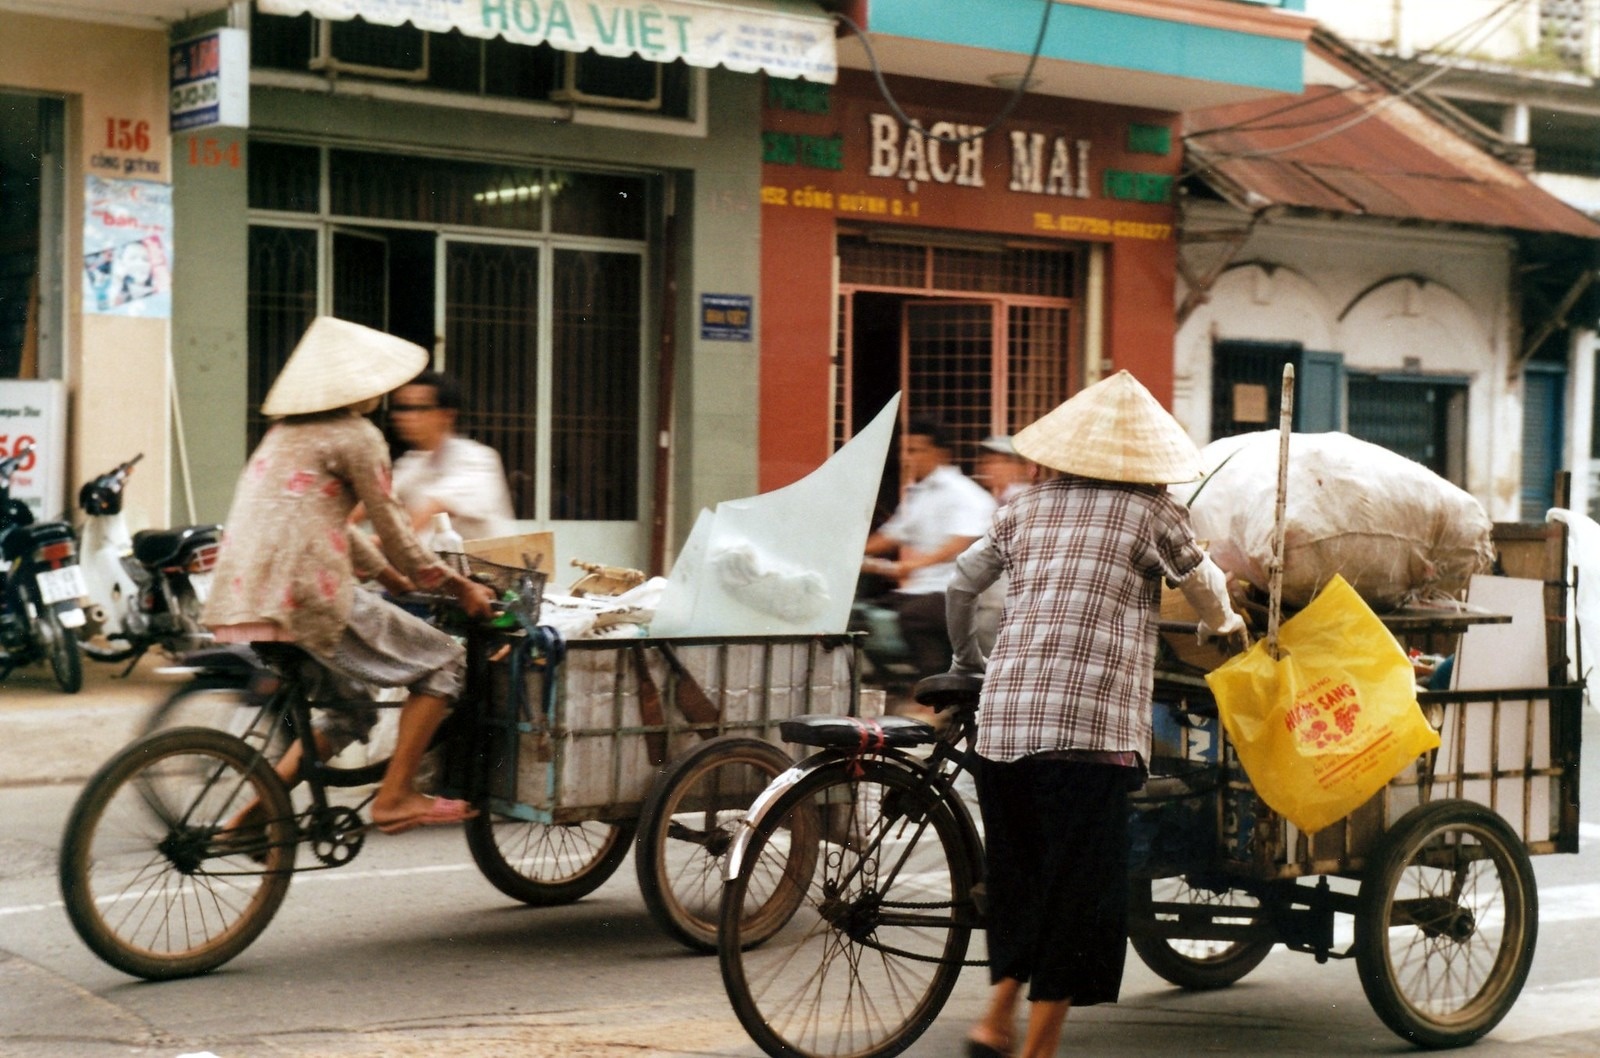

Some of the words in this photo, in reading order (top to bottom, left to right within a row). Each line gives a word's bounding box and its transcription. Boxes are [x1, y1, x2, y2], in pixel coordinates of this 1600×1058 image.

[588, 4, 693, 56] VIỆT
[104, 117, 152, 153] 156
[187, 135, 242, 170] 154
[869, 112, 986, 193] BẠCH
[1009, 130, 1092, 198] MAI
[1316, 682, 1357, 711] SANG
